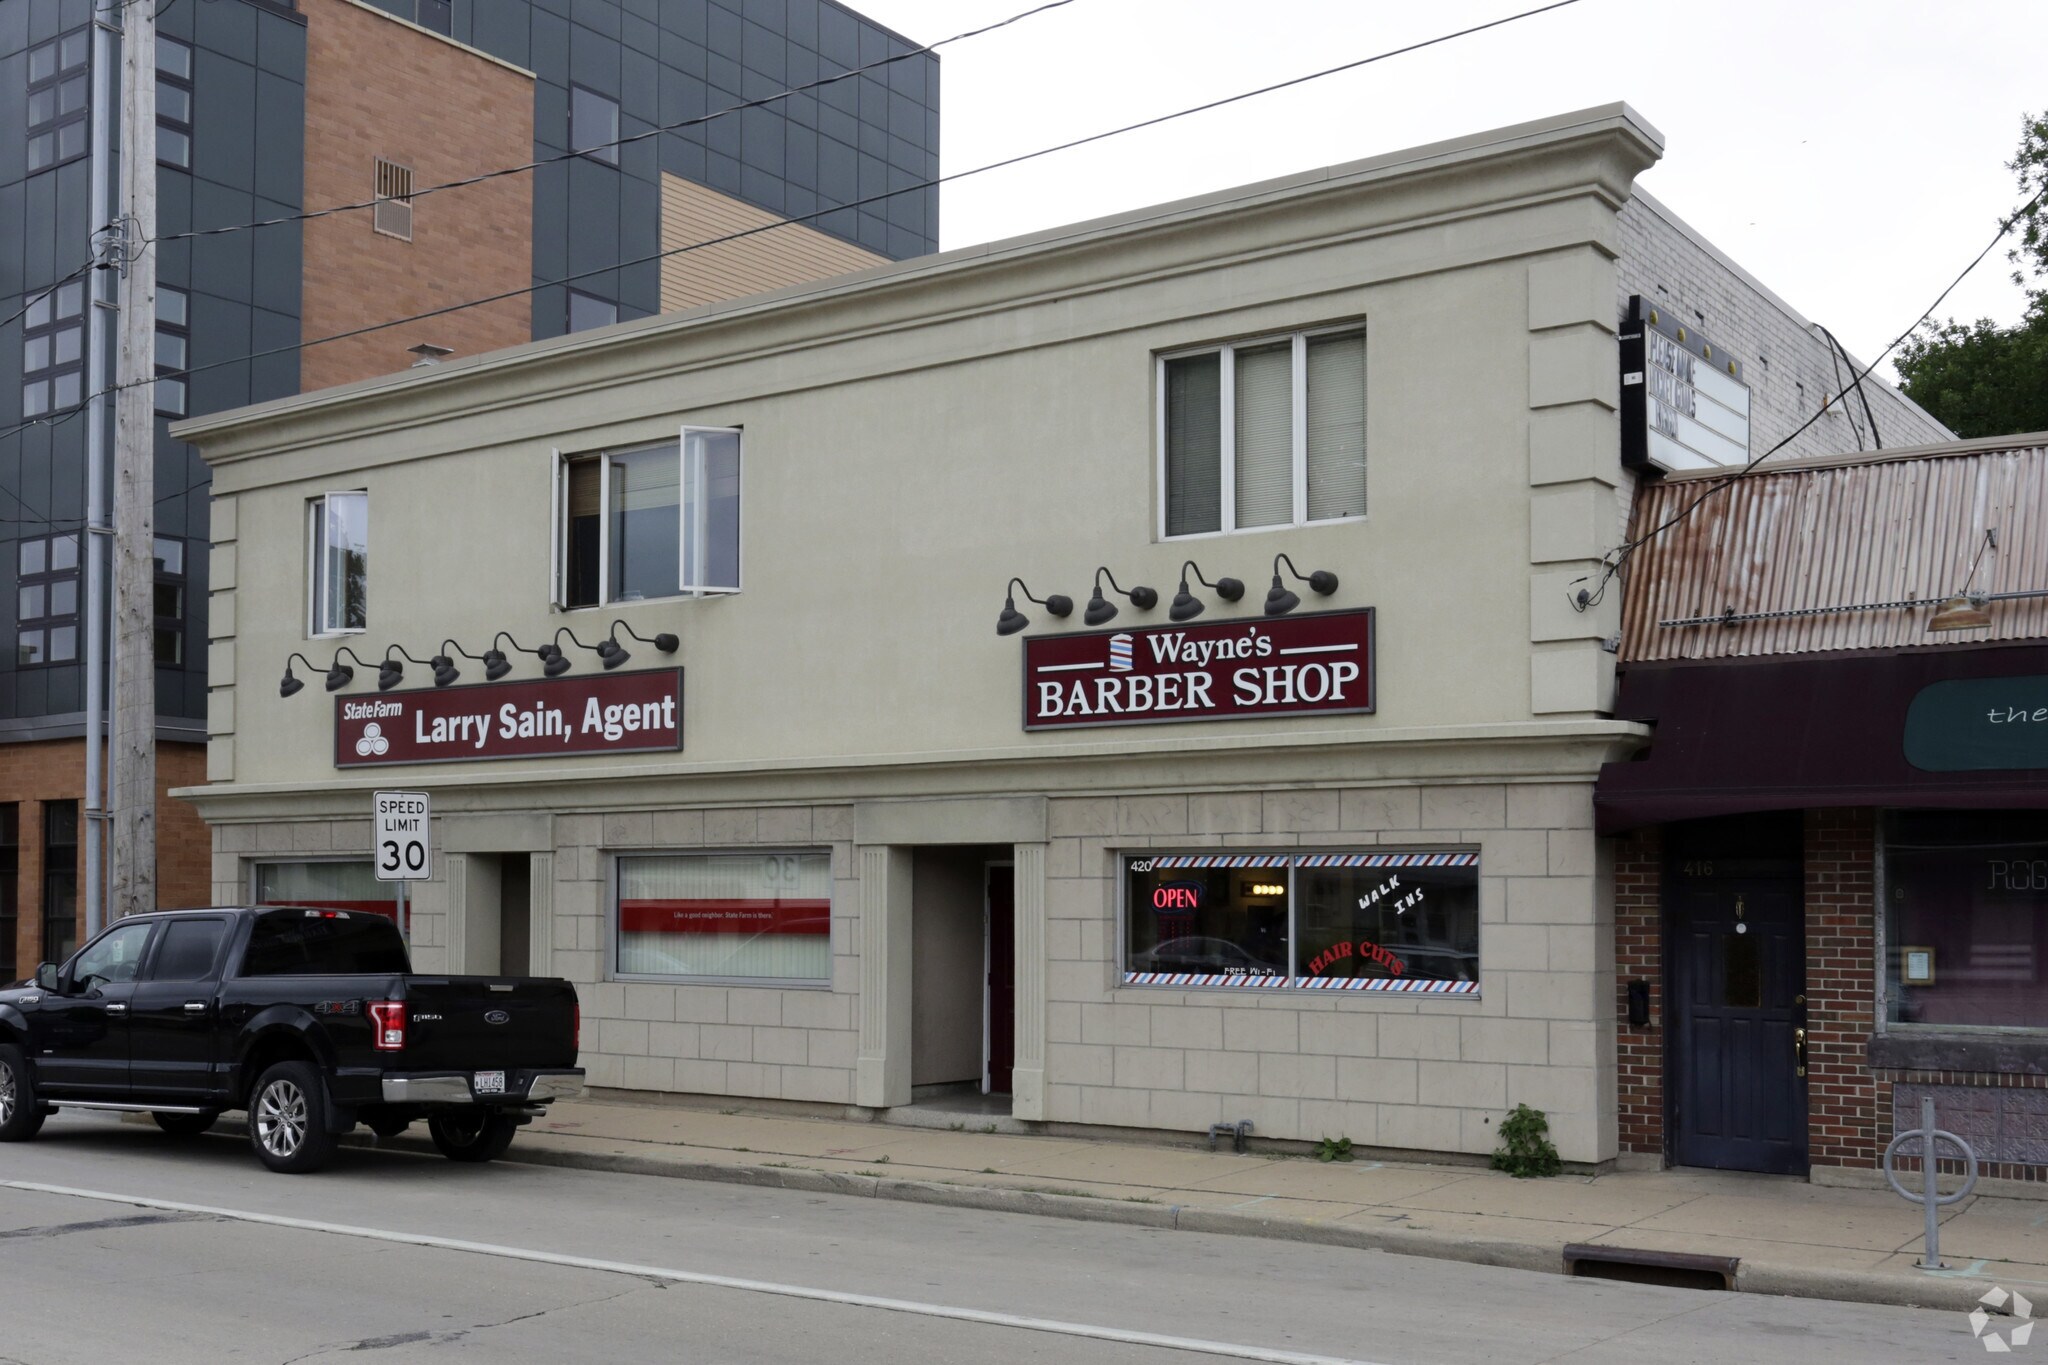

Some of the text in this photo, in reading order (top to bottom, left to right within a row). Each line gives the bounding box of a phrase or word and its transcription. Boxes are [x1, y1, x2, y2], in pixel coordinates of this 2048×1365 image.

[1147, 627, 1272, 667] Wayne's
[1037, 662, 1360, 717] BARBER SHOP
[415, 695, 676, 749] Larry Sain, Agent
[1987, 706, 2048, 724] the
[379, 800, 425, 814] SPEED
[385, 818, 420, 832] LIMIT
[381, 840, 425, 872] 30
[1131, 861, 1152, 872] 420
[1683, 860, 1713, 876] 416
[1153, 888, 1197, 908] OPEN
[1358, 874, 1400, 910] WALK
[1394, 887, 1424, 915] INS
[673, 911, 684, 919] Like
[689, 911, 701, 919] good
[725, 911, 738, 919] State
[739, 911, 752, 919] Farm
[1308, 941, 1405, 976] HAIR CUTS
[1224, 967, 1246, 976] FREE
